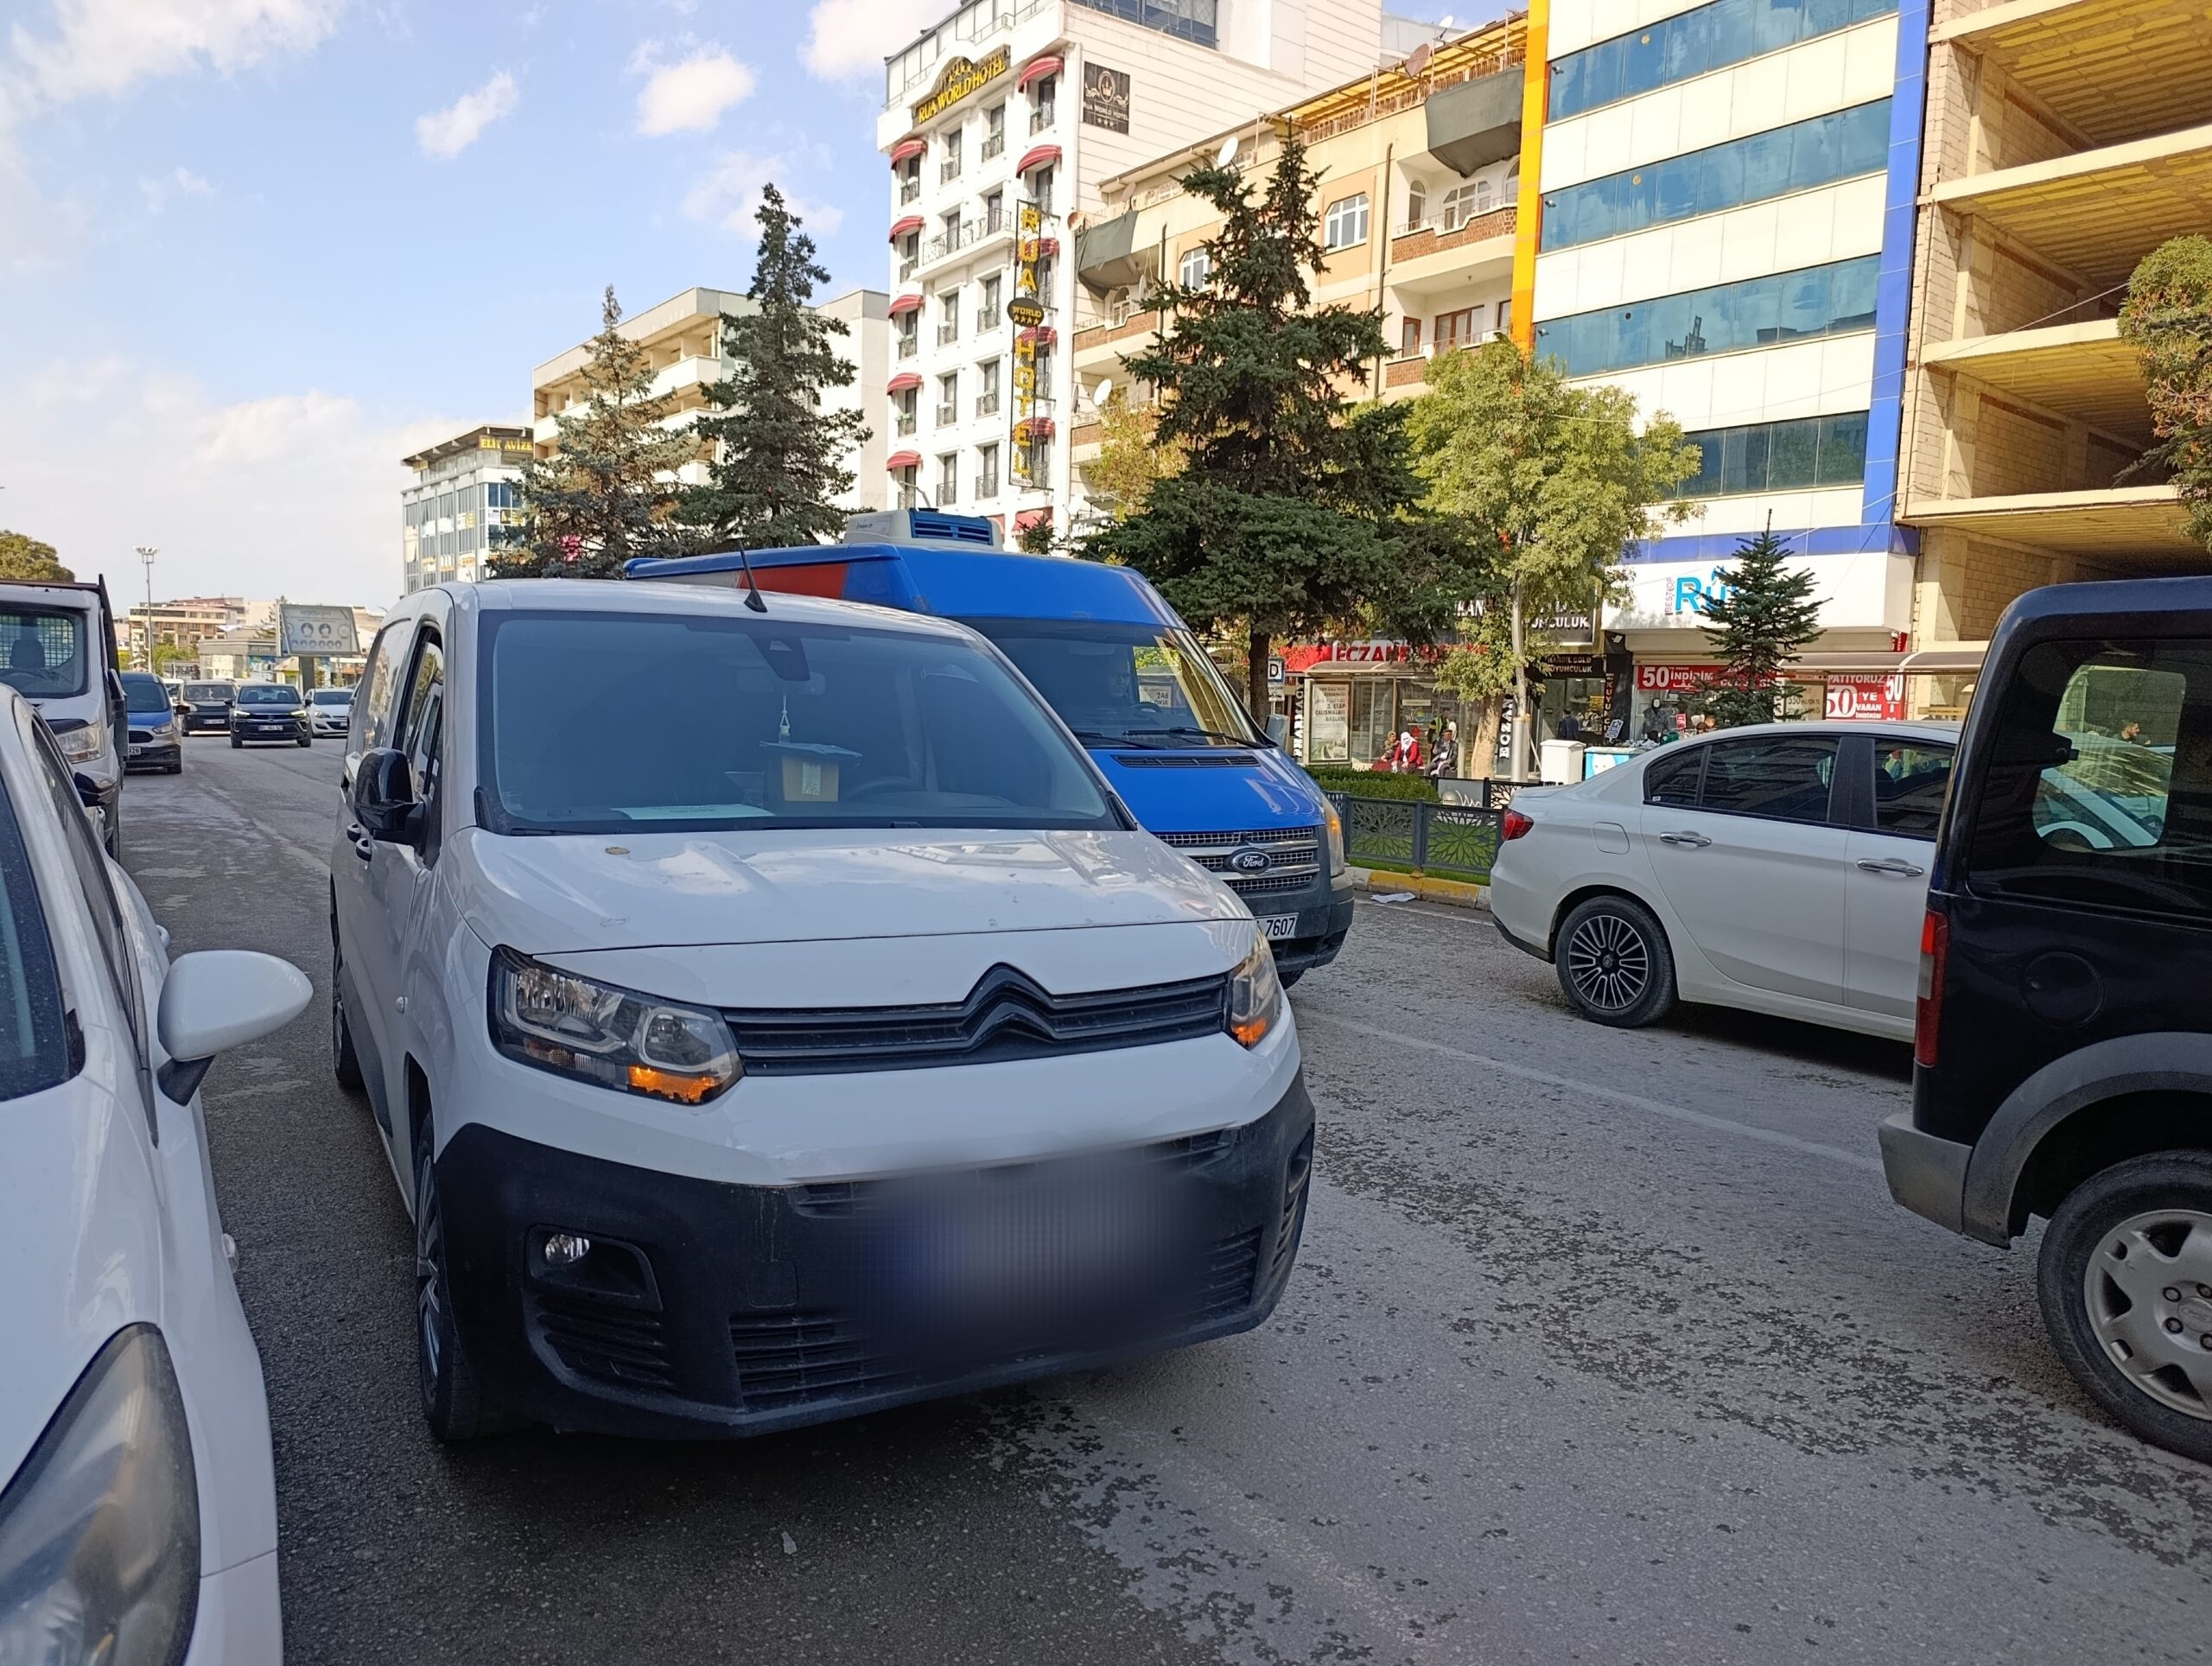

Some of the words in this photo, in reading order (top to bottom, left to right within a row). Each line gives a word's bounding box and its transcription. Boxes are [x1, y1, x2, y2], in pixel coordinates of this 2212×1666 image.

[918, 100, 938, 124] RUA
[938, 77, 973, 111] WORLD
[973, 58, 1007, 90] HOTEL
[1084, 101, 1094, 110] RUA
[1094, 105, 1112, 115] WORLD
[1113, 111, 1129, 121] HOTEL
[1019, 208, 1041, 292] RUA
[1011, 306, 1042, 318] WORLD
[1014, 336, 1035, 475] HOTEL
[480, 437, 501, 450] ELİT
[504, 438, 533, 451] AVİZE
[1269, 663, 1279, 677] D
[1549, 664, 1592, 673] UYUMCULUK
[1642, 666, 1669, 688] 50
[1885, 674, 1904, 702] 50
[1827, 688, 1854, 715] 50
[1294, 682, 1304, 757] PHARMACY
[1243, 855, 1265, 868] Ford
[1265, 917, 1296, 938] 7607
